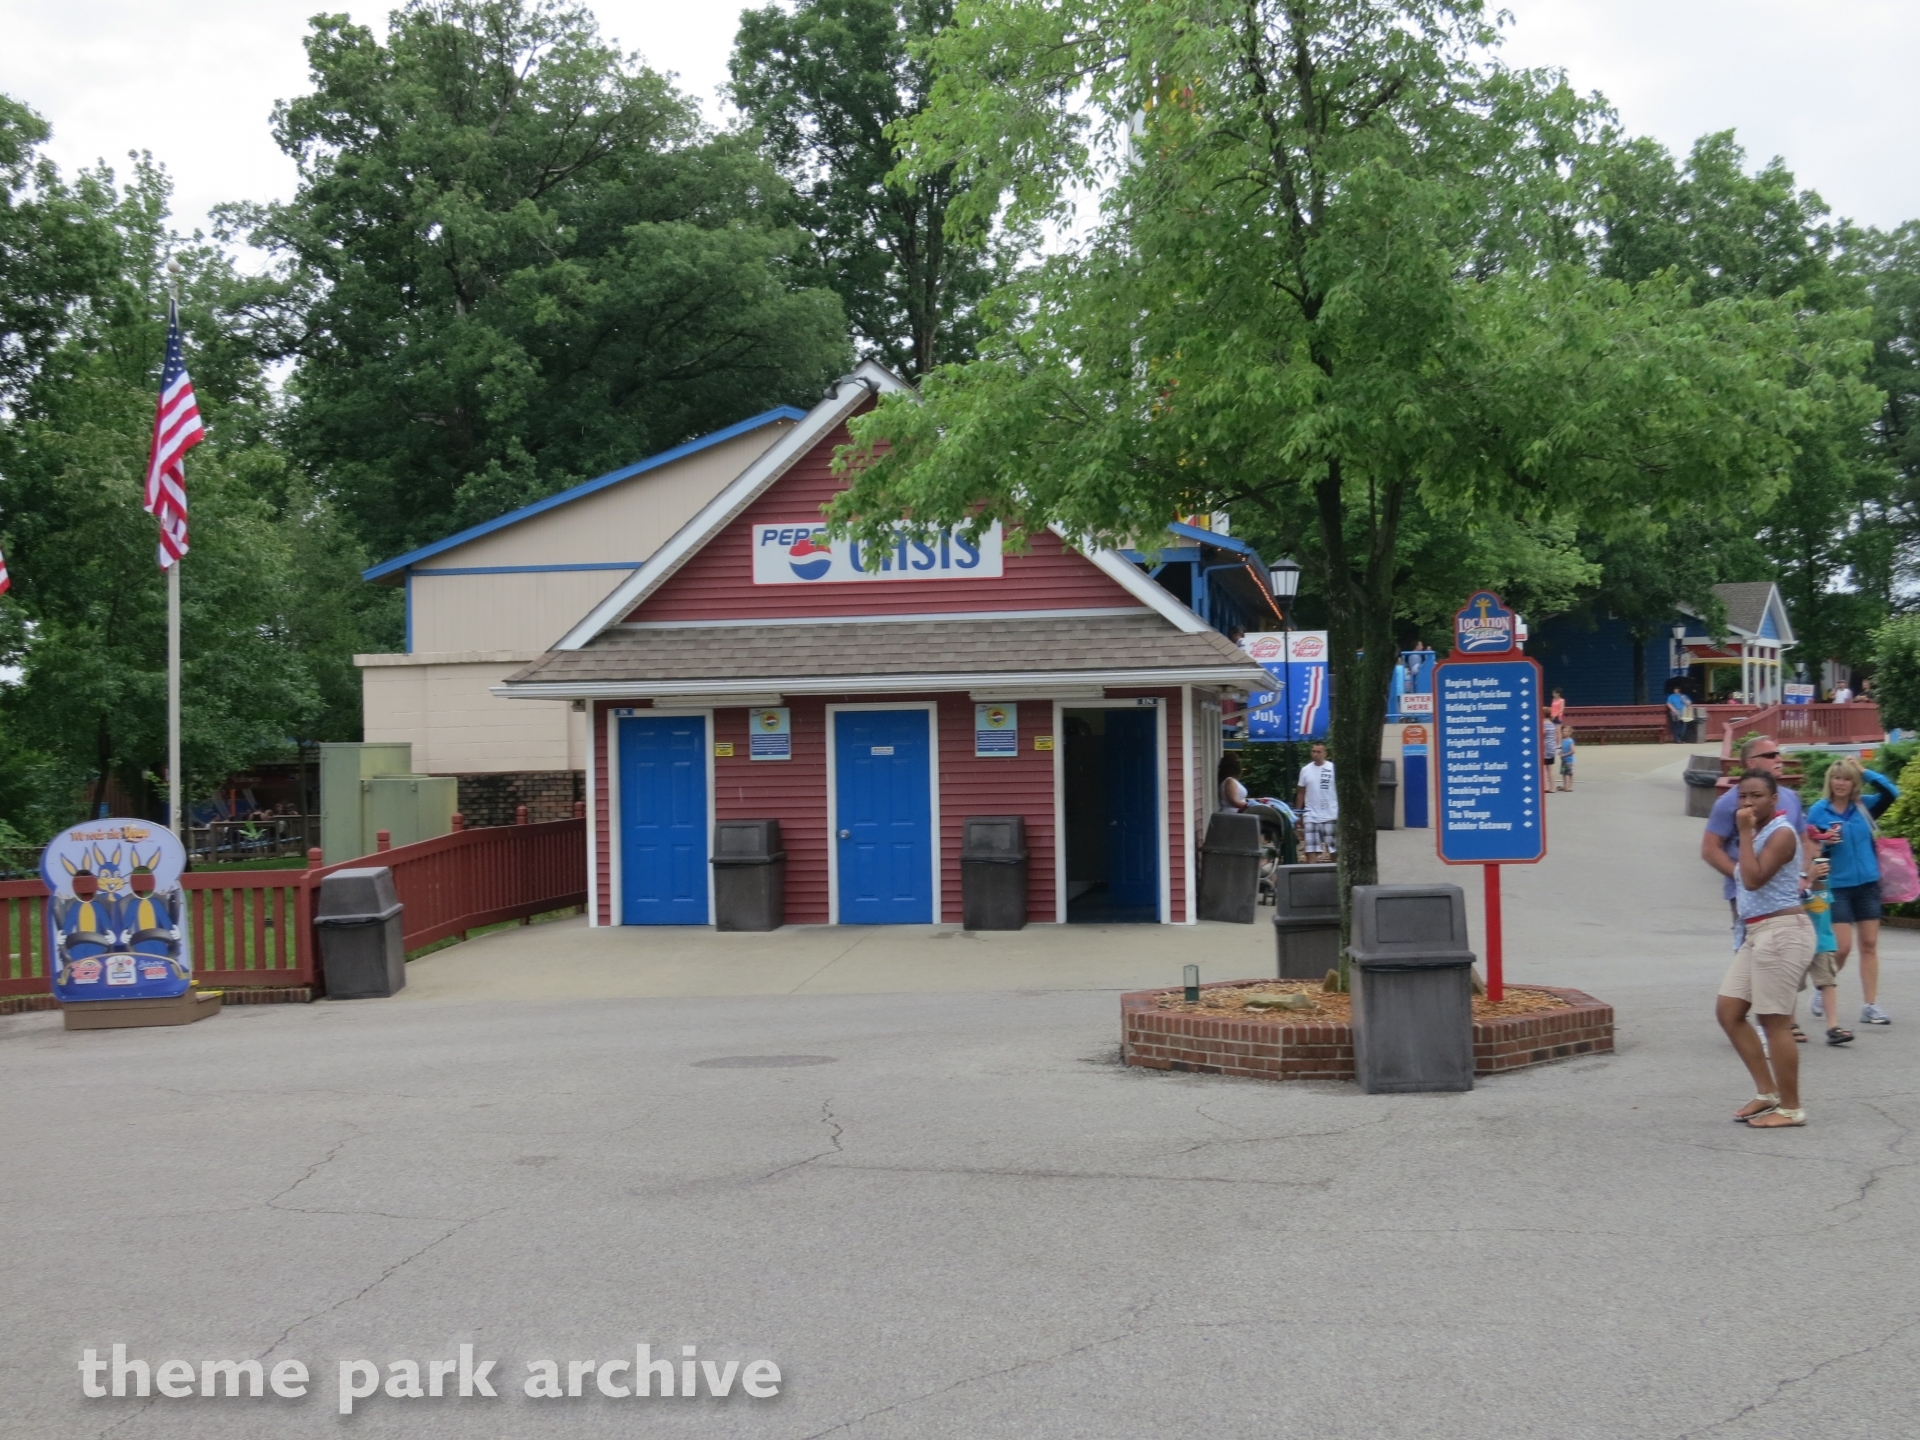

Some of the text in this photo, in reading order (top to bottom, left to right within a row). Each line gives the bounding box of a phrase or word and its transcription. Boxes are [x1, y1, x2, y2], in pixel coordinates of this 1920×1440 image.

[1458, 616, 1510, 632] LOCATION
[1445, 677, 1499, 688] Raging Rapids
[1259, 692, 1275, 704] of
[1252, 710, 1282, 728] July
[1446, 715, 1487, 723] Restrooms
[1446, 726, 1506, 735] Hoosier Theater
[1446, 737, 1500, 748] Frightful Falls
[1447, 750, 1479, 759] First Aid
[1483, 762, 1508, 770] Safari
[1320, 767, 1332, 790] AERO
[1448, 786, 1500, 796] Smoking Area
[1448, 798, 1476, 808] Legend
[1448, 810, 1491, 819] The Voyage
[1448, 821, 1512, 831] Gobbler Getaway
